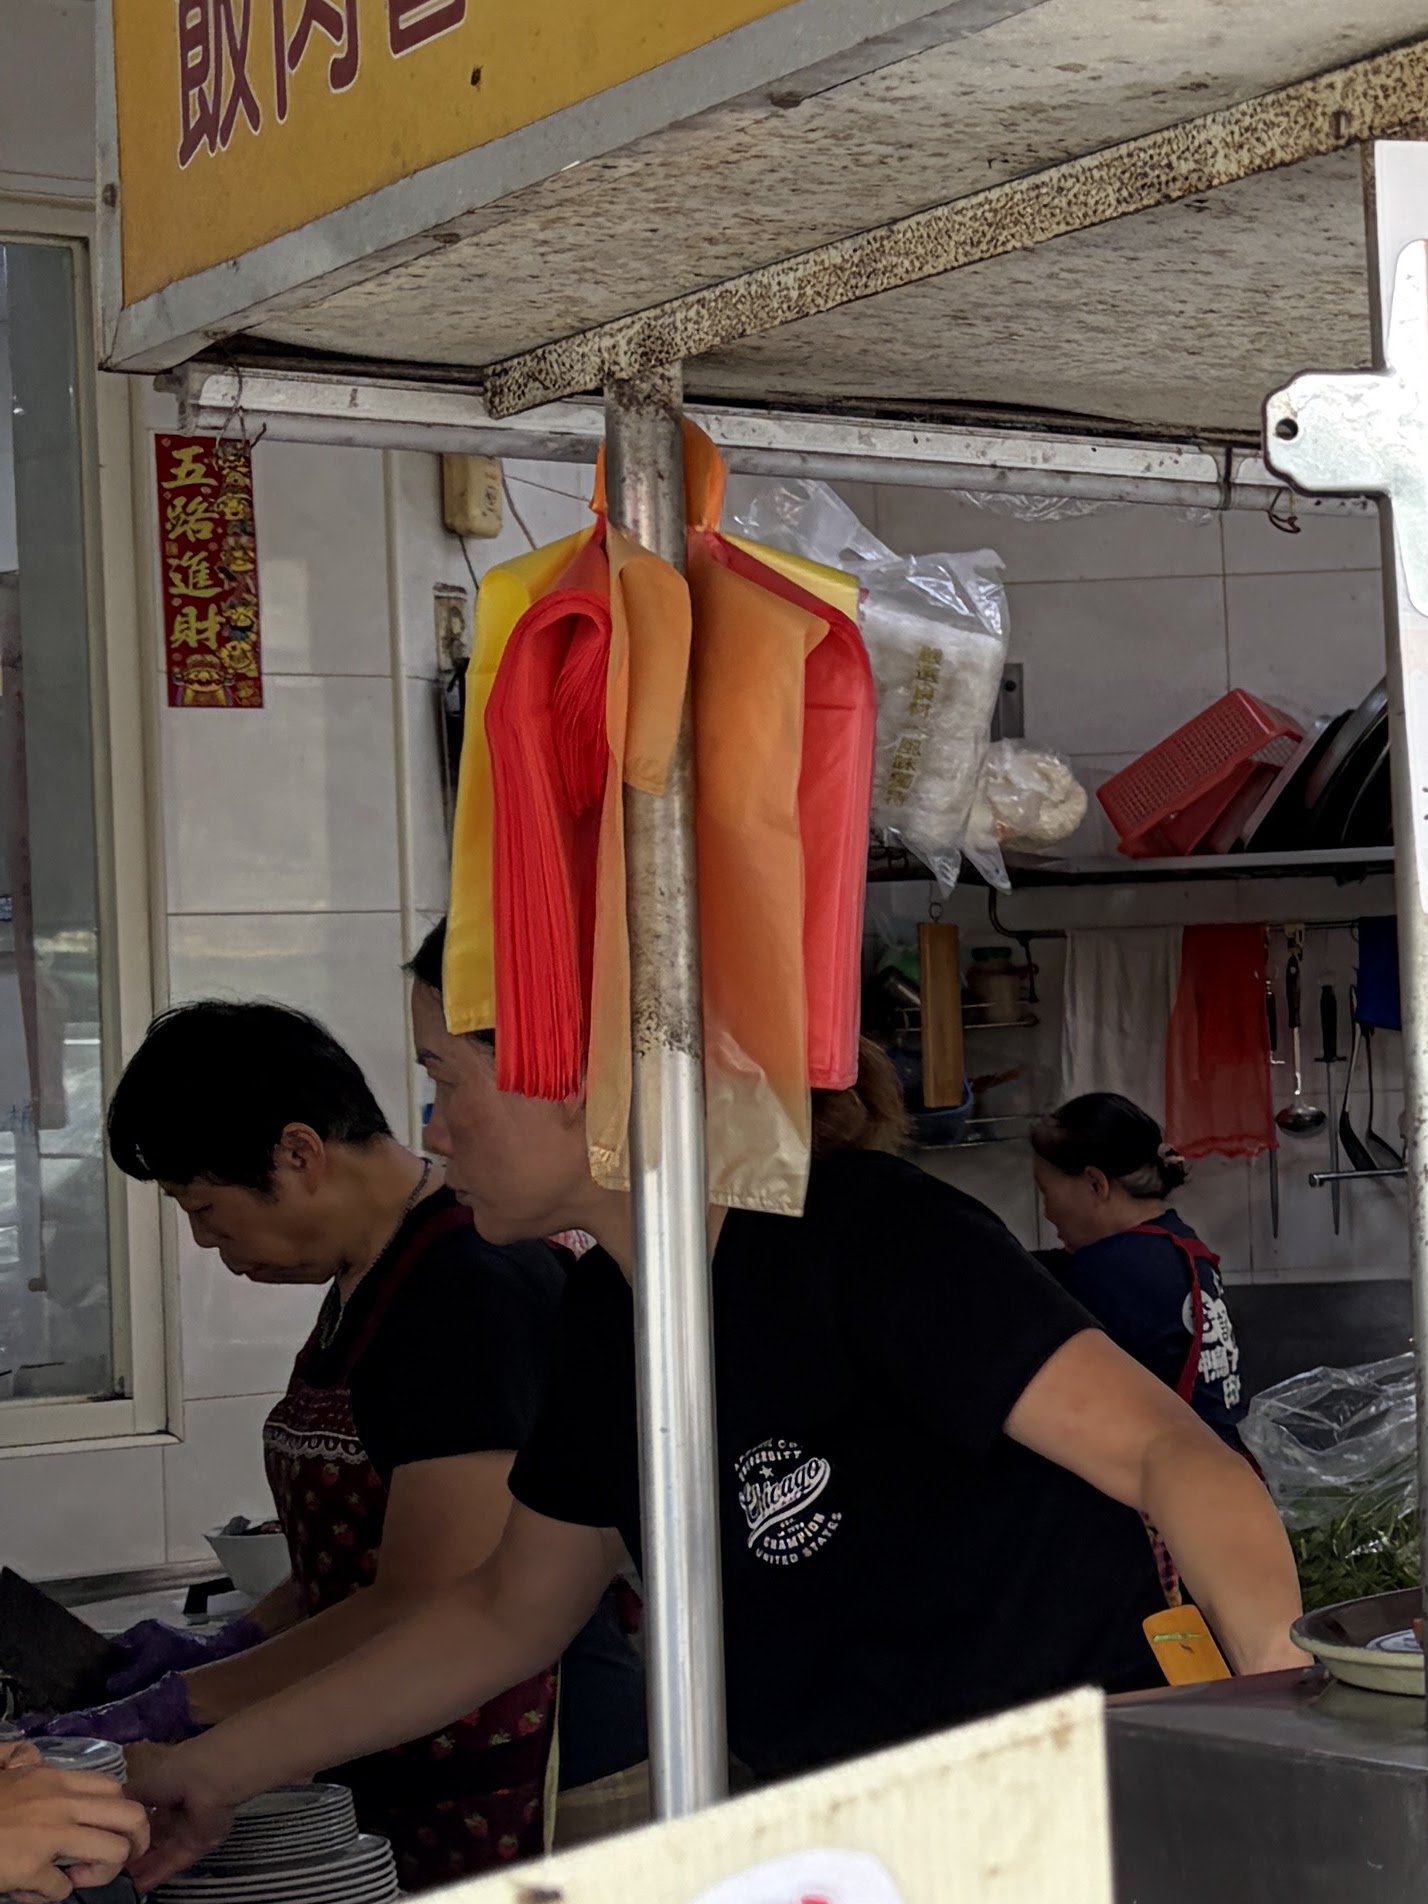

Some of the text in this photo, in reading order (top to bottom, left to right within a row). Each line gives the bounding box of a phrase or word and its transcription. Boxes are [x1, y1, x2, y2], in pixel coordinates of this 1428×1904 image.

[161, 445, 226, 650] 五路進財
[739, 1457, 823, 1528] Chicago
